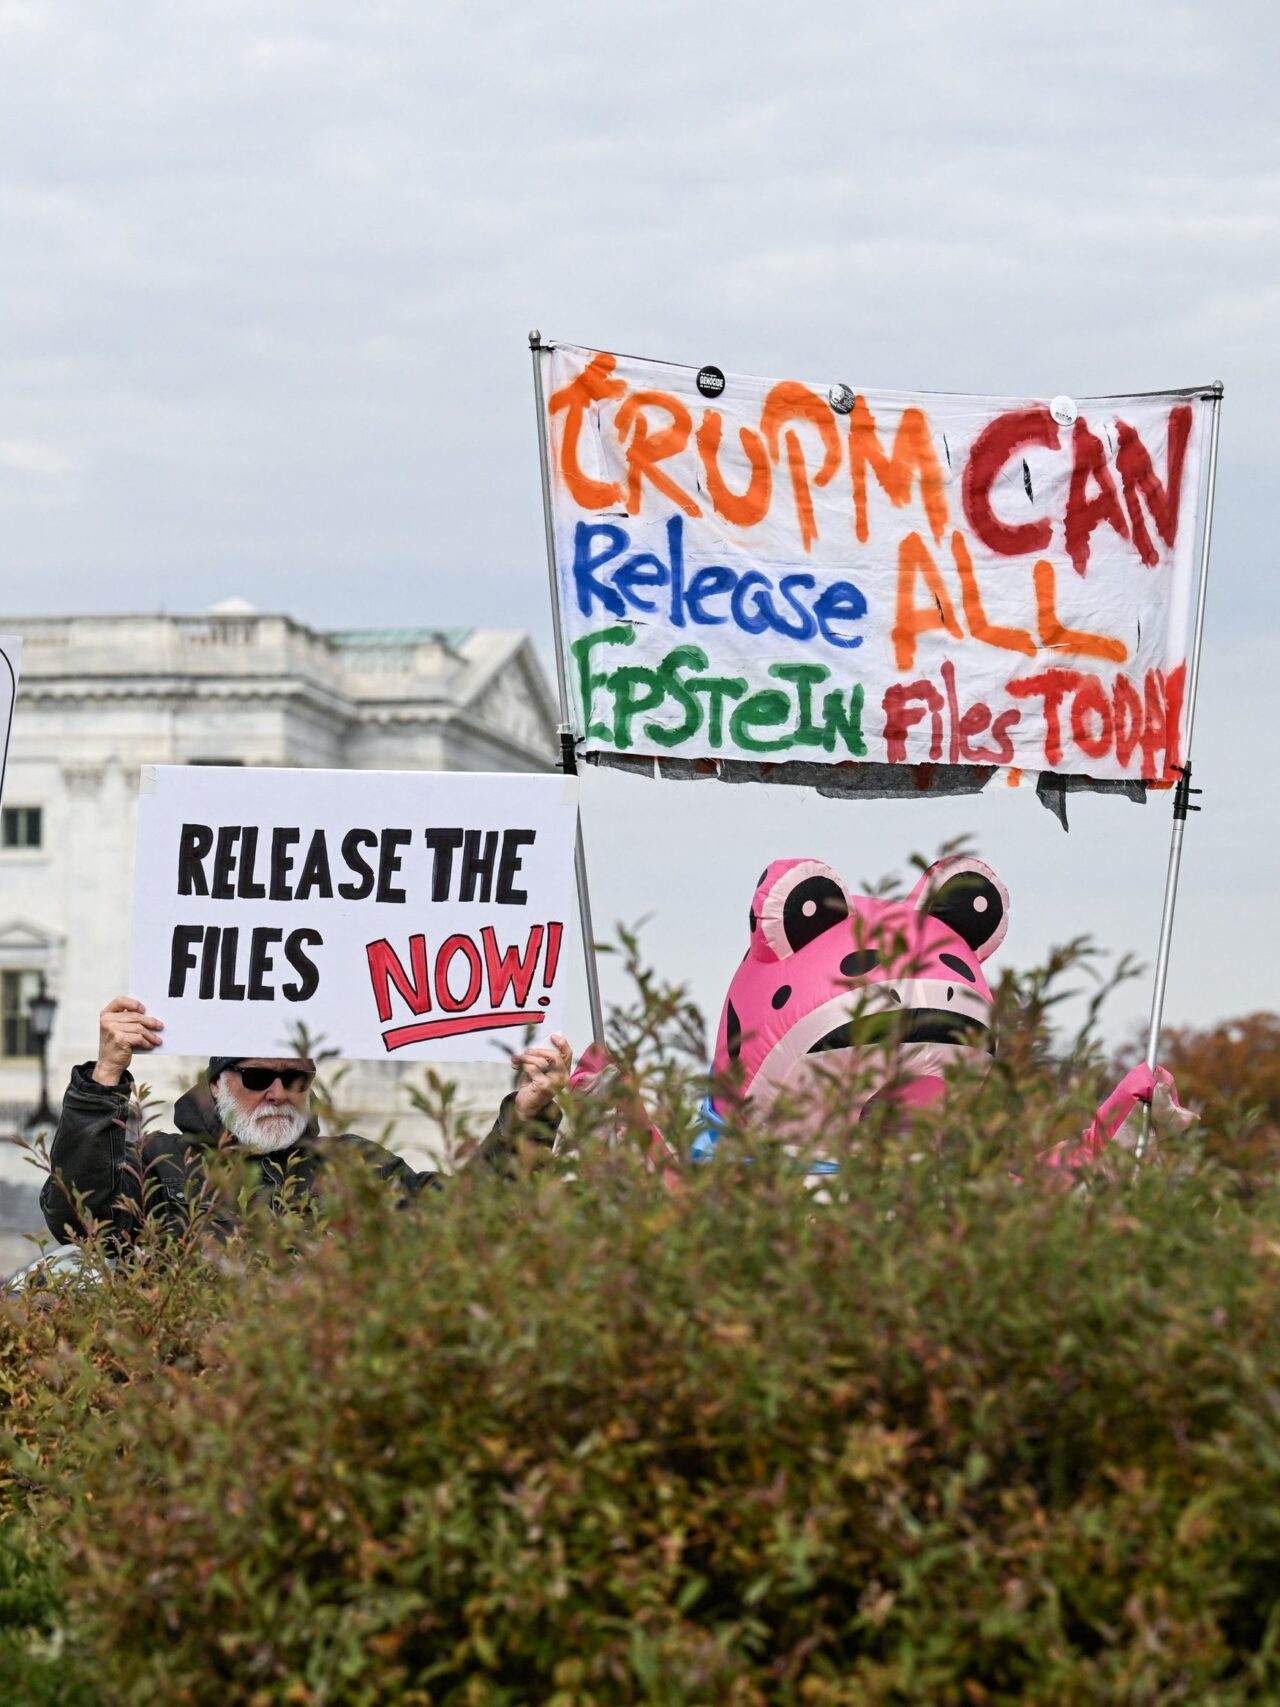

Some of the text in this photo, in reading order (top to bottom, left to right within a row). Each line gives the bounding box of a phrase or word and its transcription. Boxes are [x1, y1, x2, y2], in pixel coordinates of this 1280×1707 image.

[961, 404, 1195, 577] CAN
[571, 515, 1128, 671] Release ALL
[881, 660, 1021, 765] Files
[177, 823, 538, 906] RELEASE THE
[168, 921, 564, 1023] FILES NOW!
